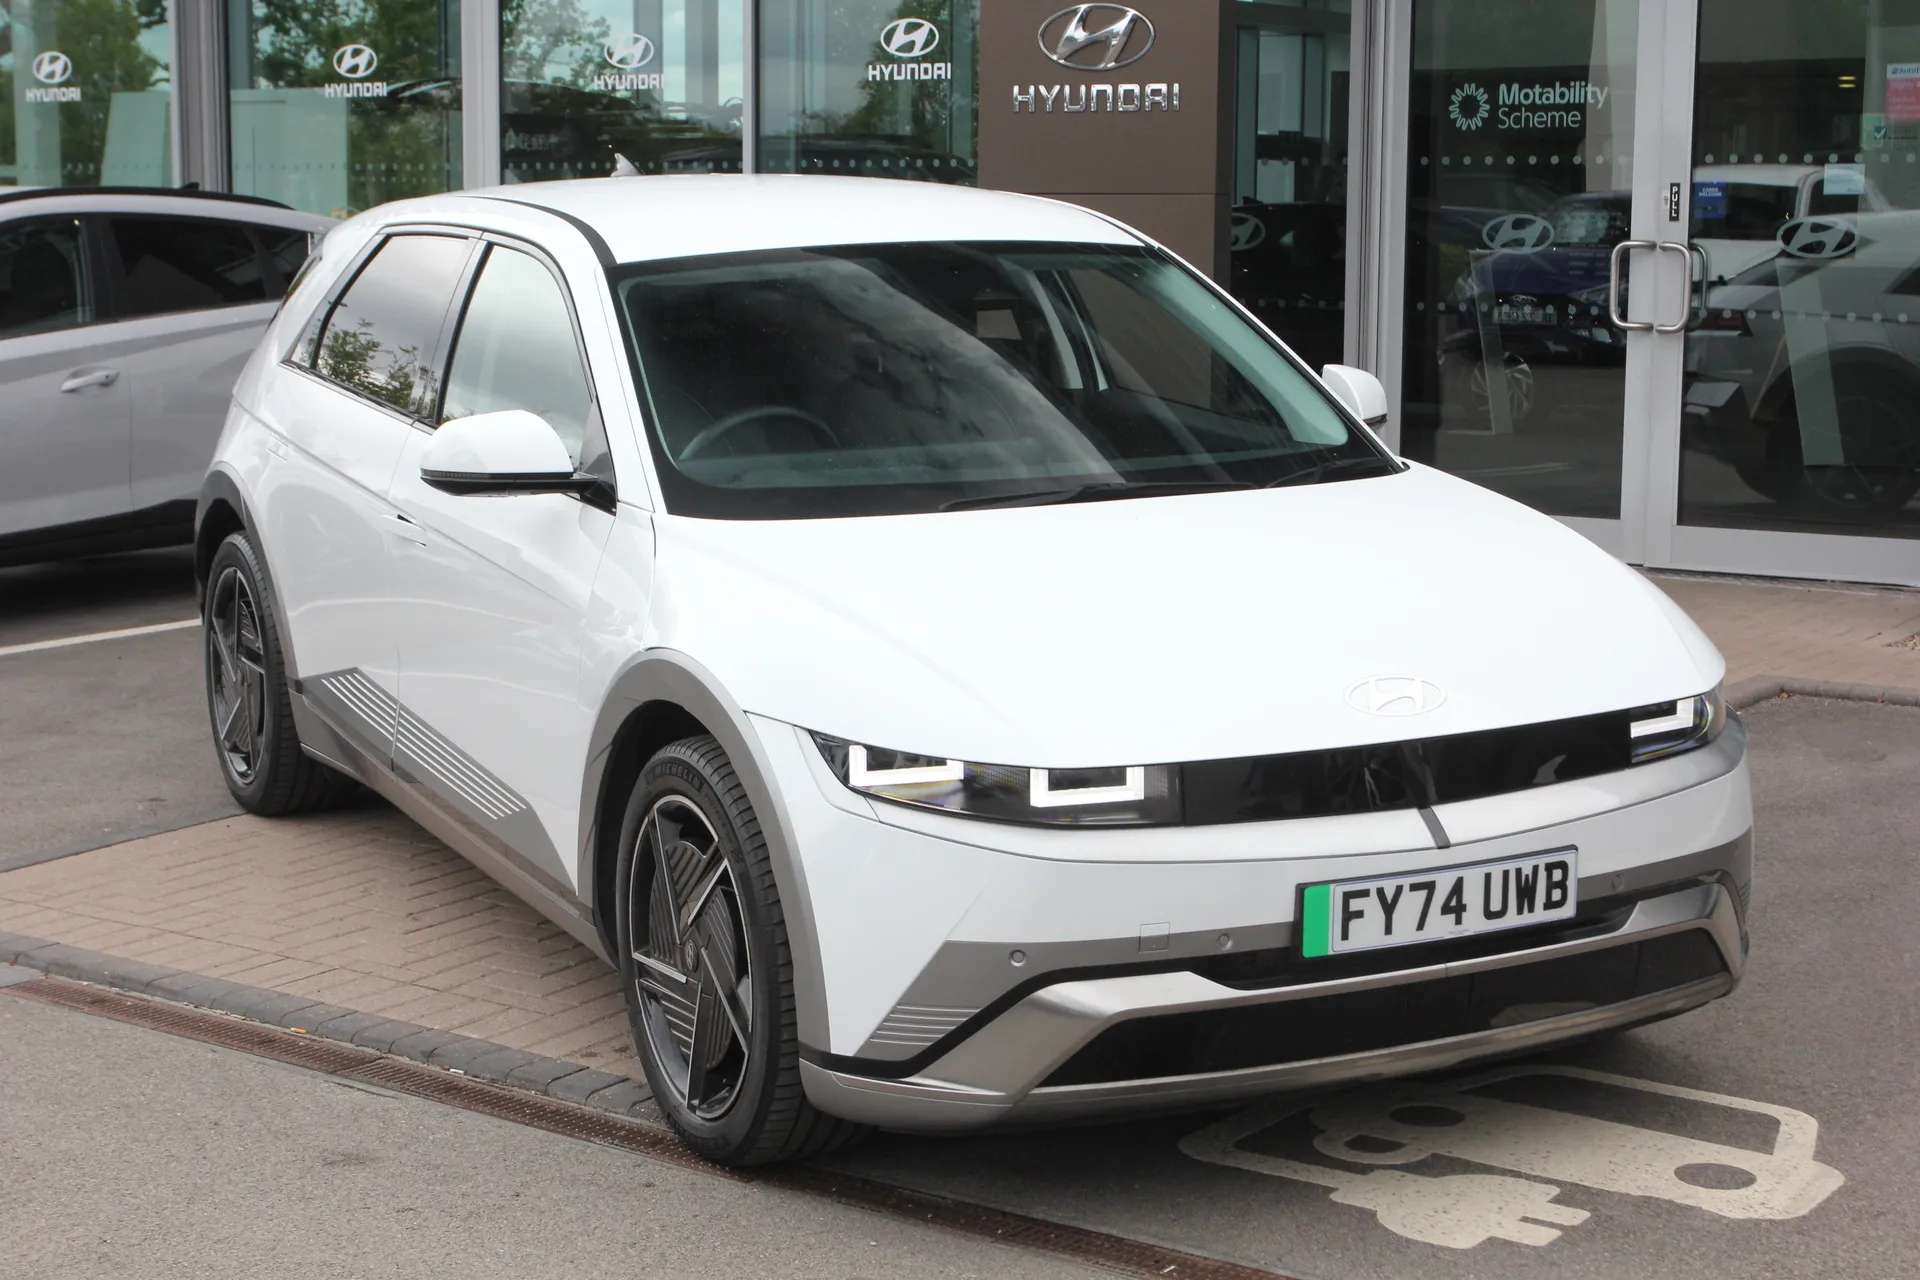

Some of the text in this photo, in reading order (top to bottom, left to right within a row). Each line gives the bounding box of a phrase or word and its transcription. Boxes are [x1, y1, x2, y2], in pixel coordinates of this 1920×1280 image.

[593, 73, 664, 90] HYUNDAI
[868, 62, 951, 81] HYUNDAI
[26, 87, 81, 102] HYUNDAI
[324, 82, 387, 98] HYUNDAI
[1013, 83, 1179, 112] HYUNDAI
[1499, 81, 1608, 109] Motability
[1498, 107, 1581, 128] Scheme
[1341, 860, 1569, 941] FY74 UWB
